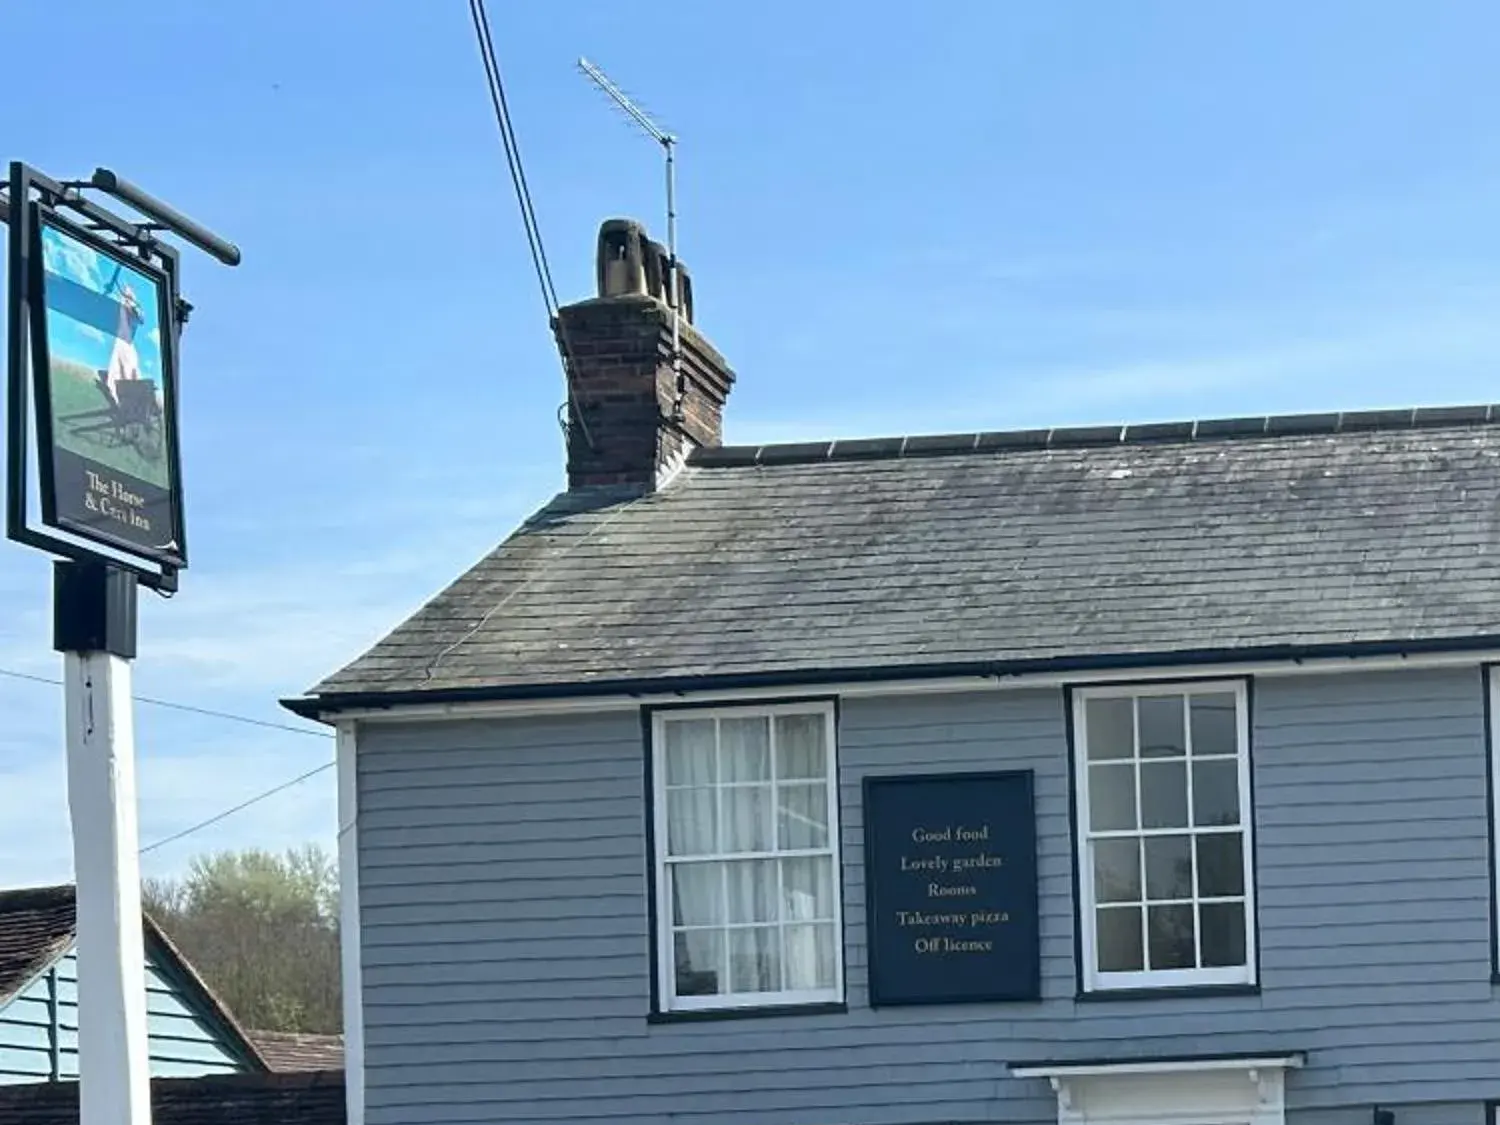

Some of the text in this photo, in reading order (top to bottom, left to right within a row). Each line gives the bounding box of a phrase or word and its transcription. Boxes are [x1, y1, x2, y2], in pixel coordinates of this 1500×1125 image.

[85, 470, 145, 508] The Horse
[85, 491, 99, 512] &
[912, 825, 989, 842] Good food
[901, 854, 1003, 873] Lovely garden
[928, 883, 977, 898] Rooms
[896, 911, 1010, 928] Takeaway pizza
[915, 938, 993, 953] Off licence
